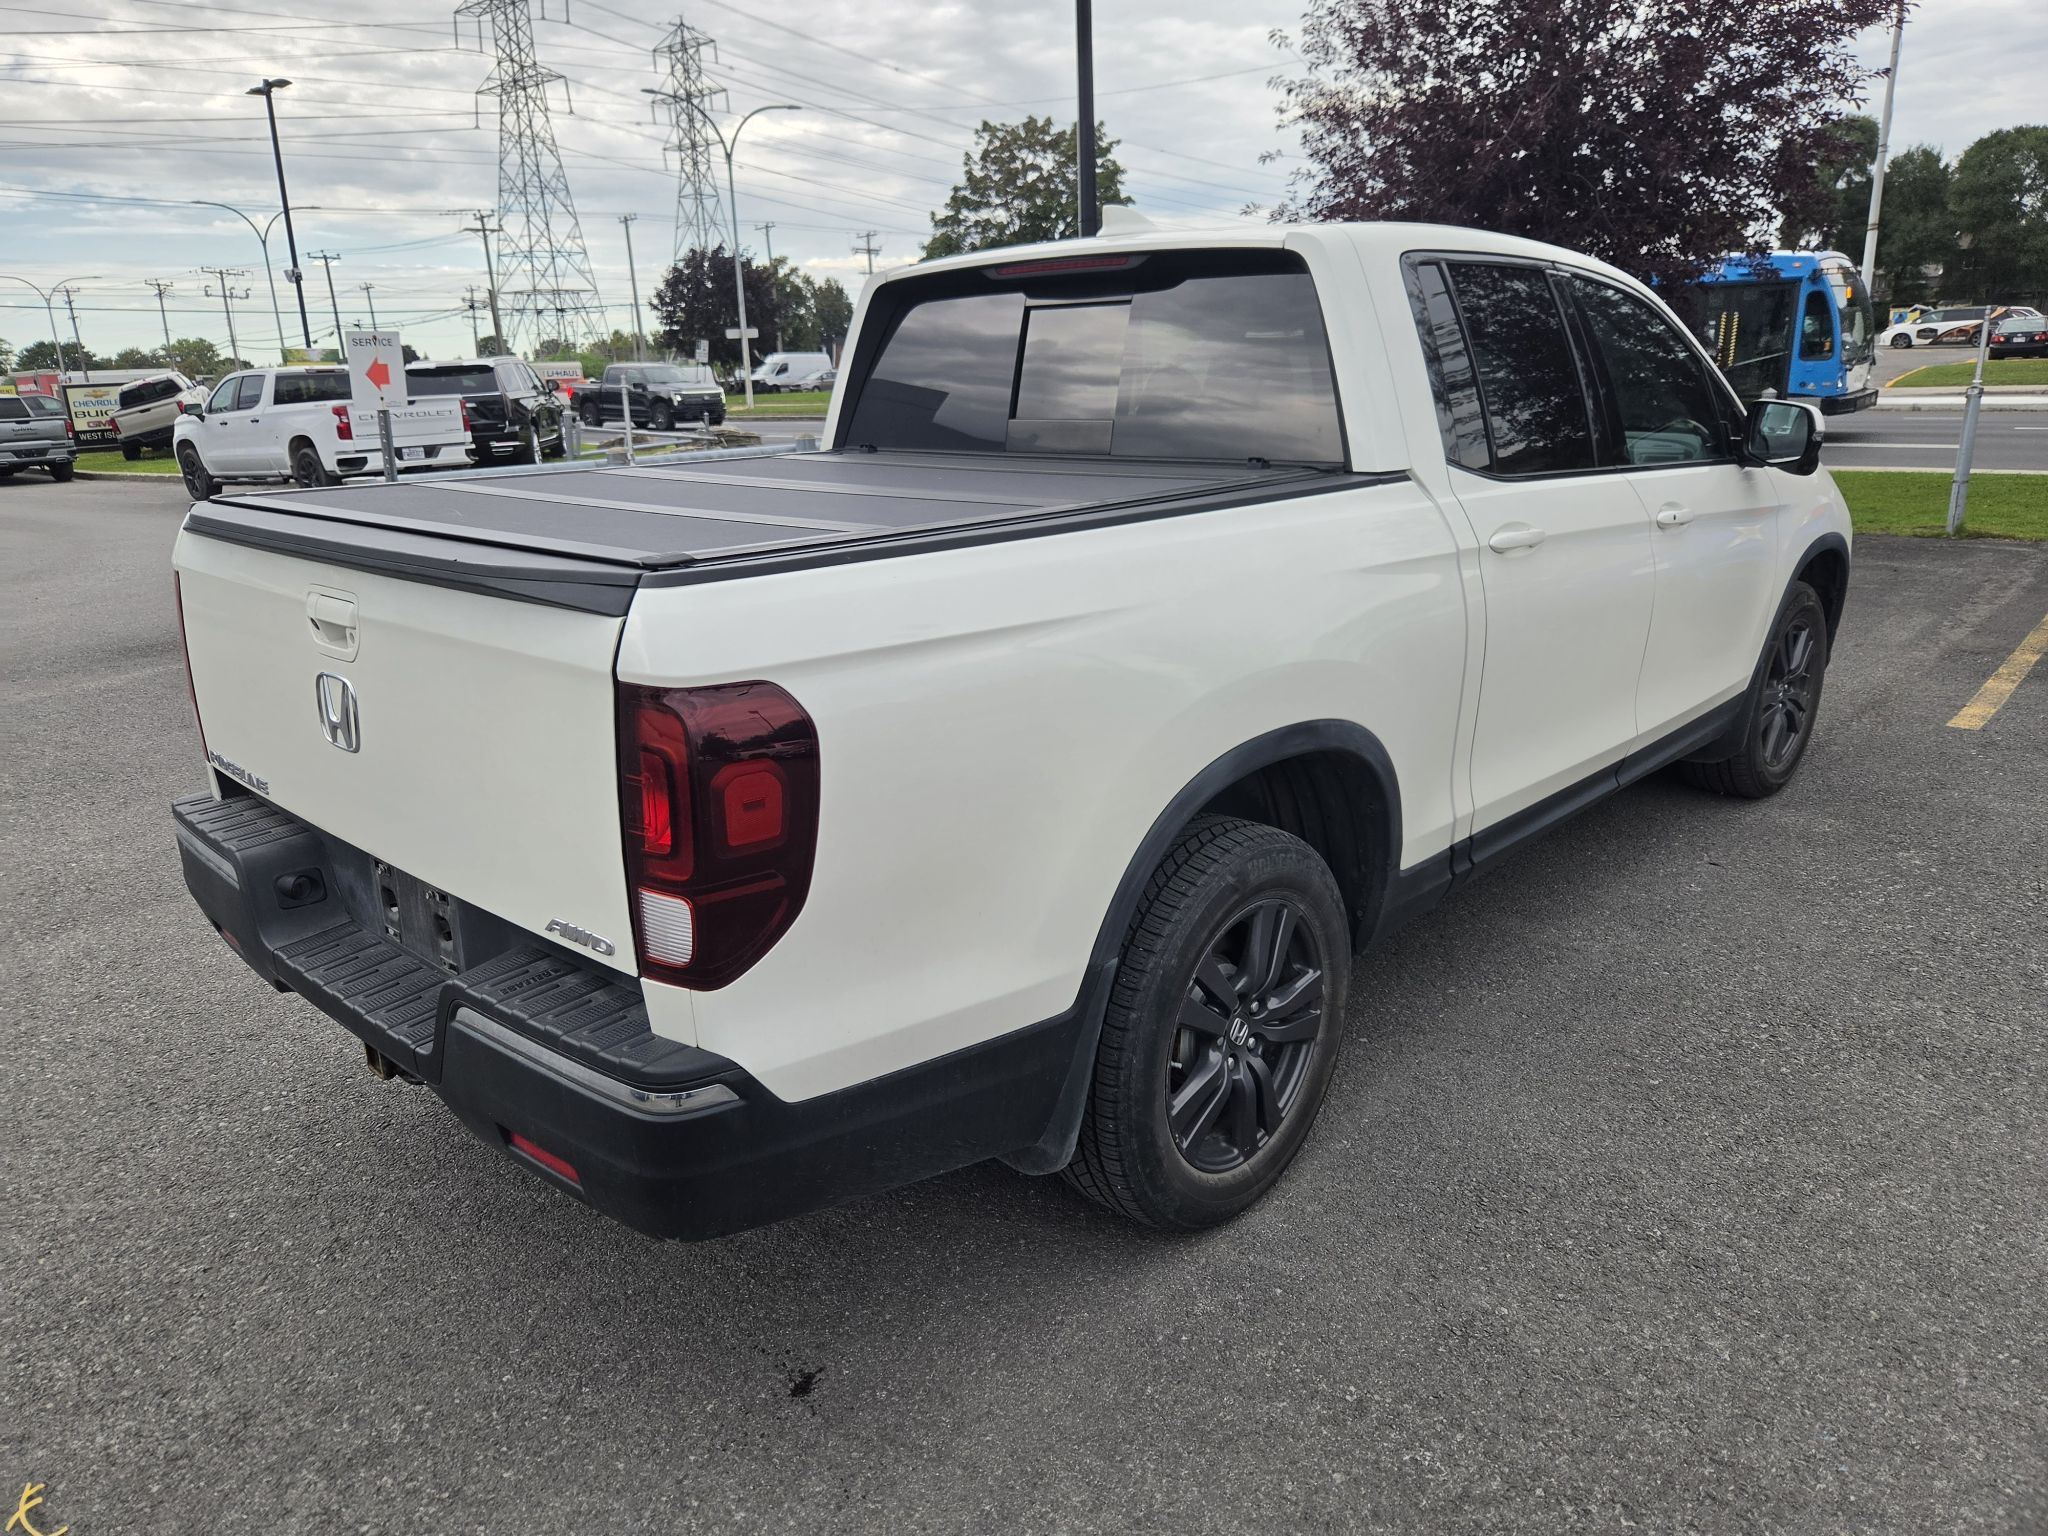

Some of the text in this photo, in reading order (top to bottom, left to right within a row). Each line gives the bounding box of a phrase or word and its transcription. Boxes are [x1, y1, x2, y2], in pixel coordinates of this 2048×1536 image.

[351, 337, 393, 347] SERVICE
[73, 399, 119, 408] CHEVROLE
[74, 409, 115, 419] BUIC
[358, 409, 455, 421] CHVROLET
[79, 432, 103, 441] WEST
[209, 750, 270, 795] RIDGELINE
[545, 918, 616, 957] AWD
